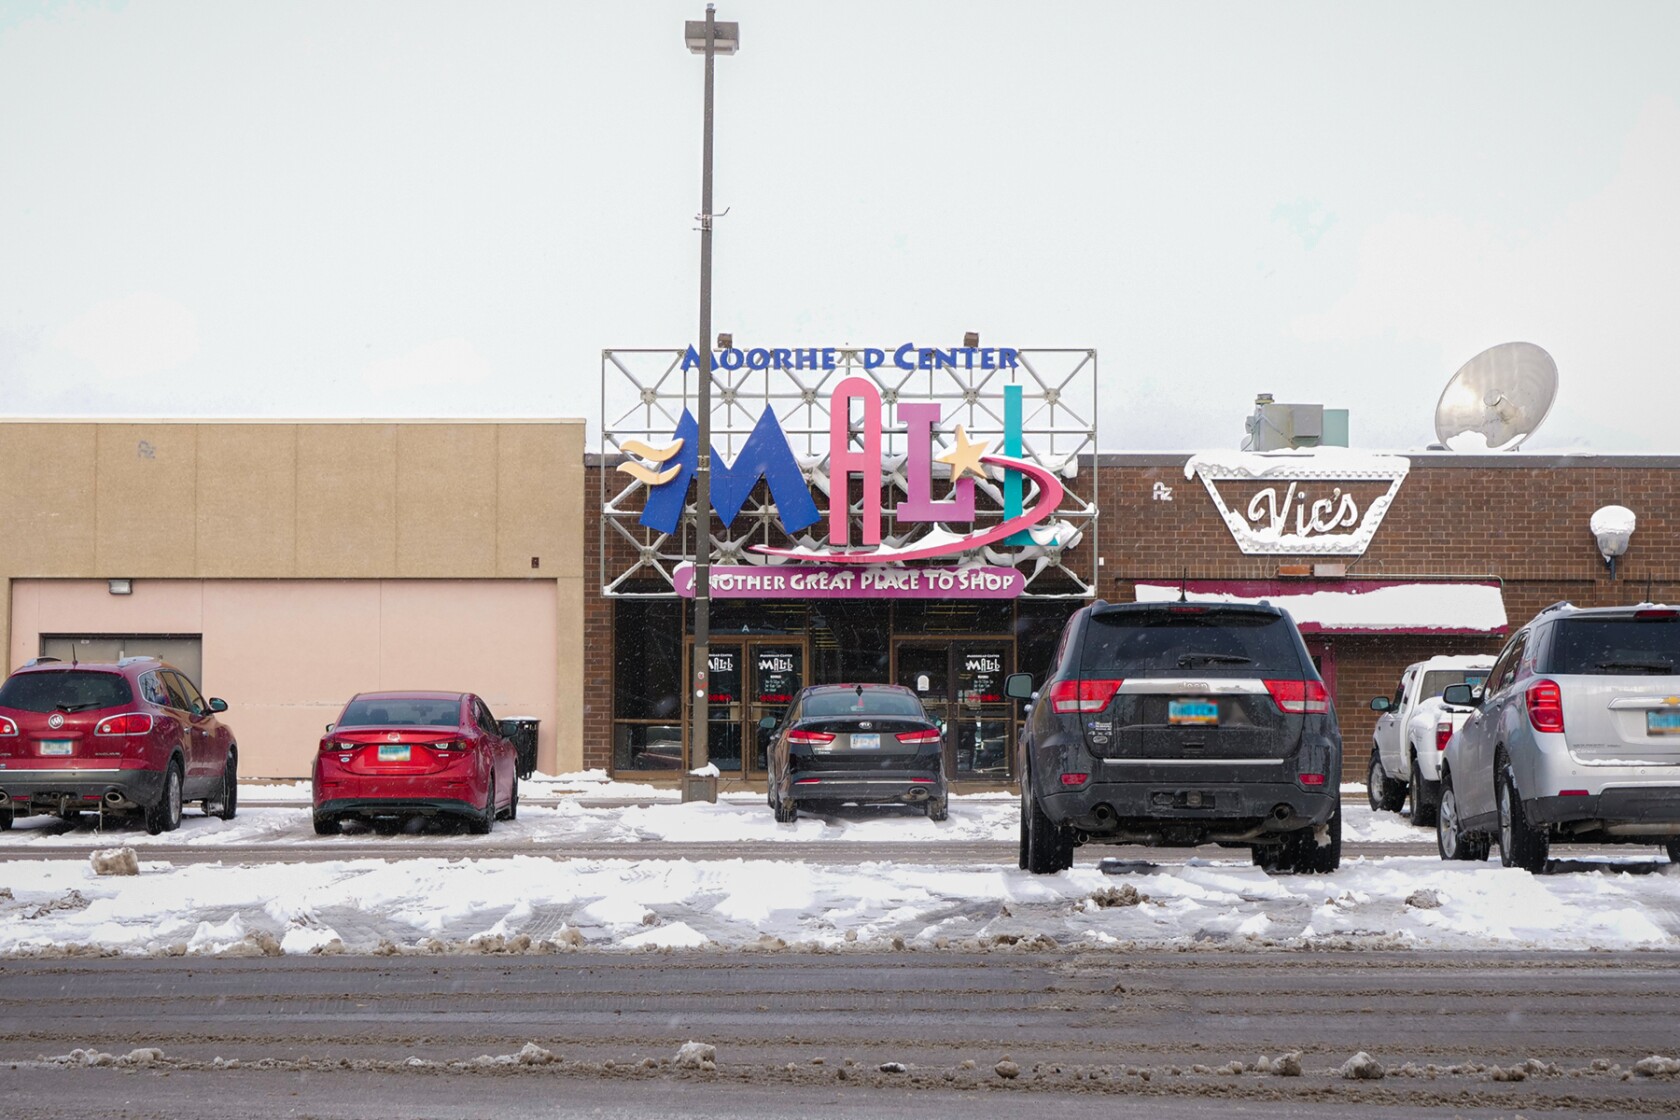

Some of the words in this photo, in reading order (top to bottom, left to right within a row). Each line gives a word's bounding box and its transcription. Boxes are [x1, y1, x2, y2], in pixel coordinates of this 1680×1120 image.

[893, 342, 1019, 370] CENTER
[639, 376, 1060, 547] MALL
[1248, 481, 1358, 537] Vic's
[790, 572, 855, 590] GREAT
[861, 572, 920, 590] PLACE
[923, 572, 954, 590] TO
[959, 571, 1014, 590] SHOP
[759, 658, 793, 672] MALL
[966, 658, 1000, 672] MALL
